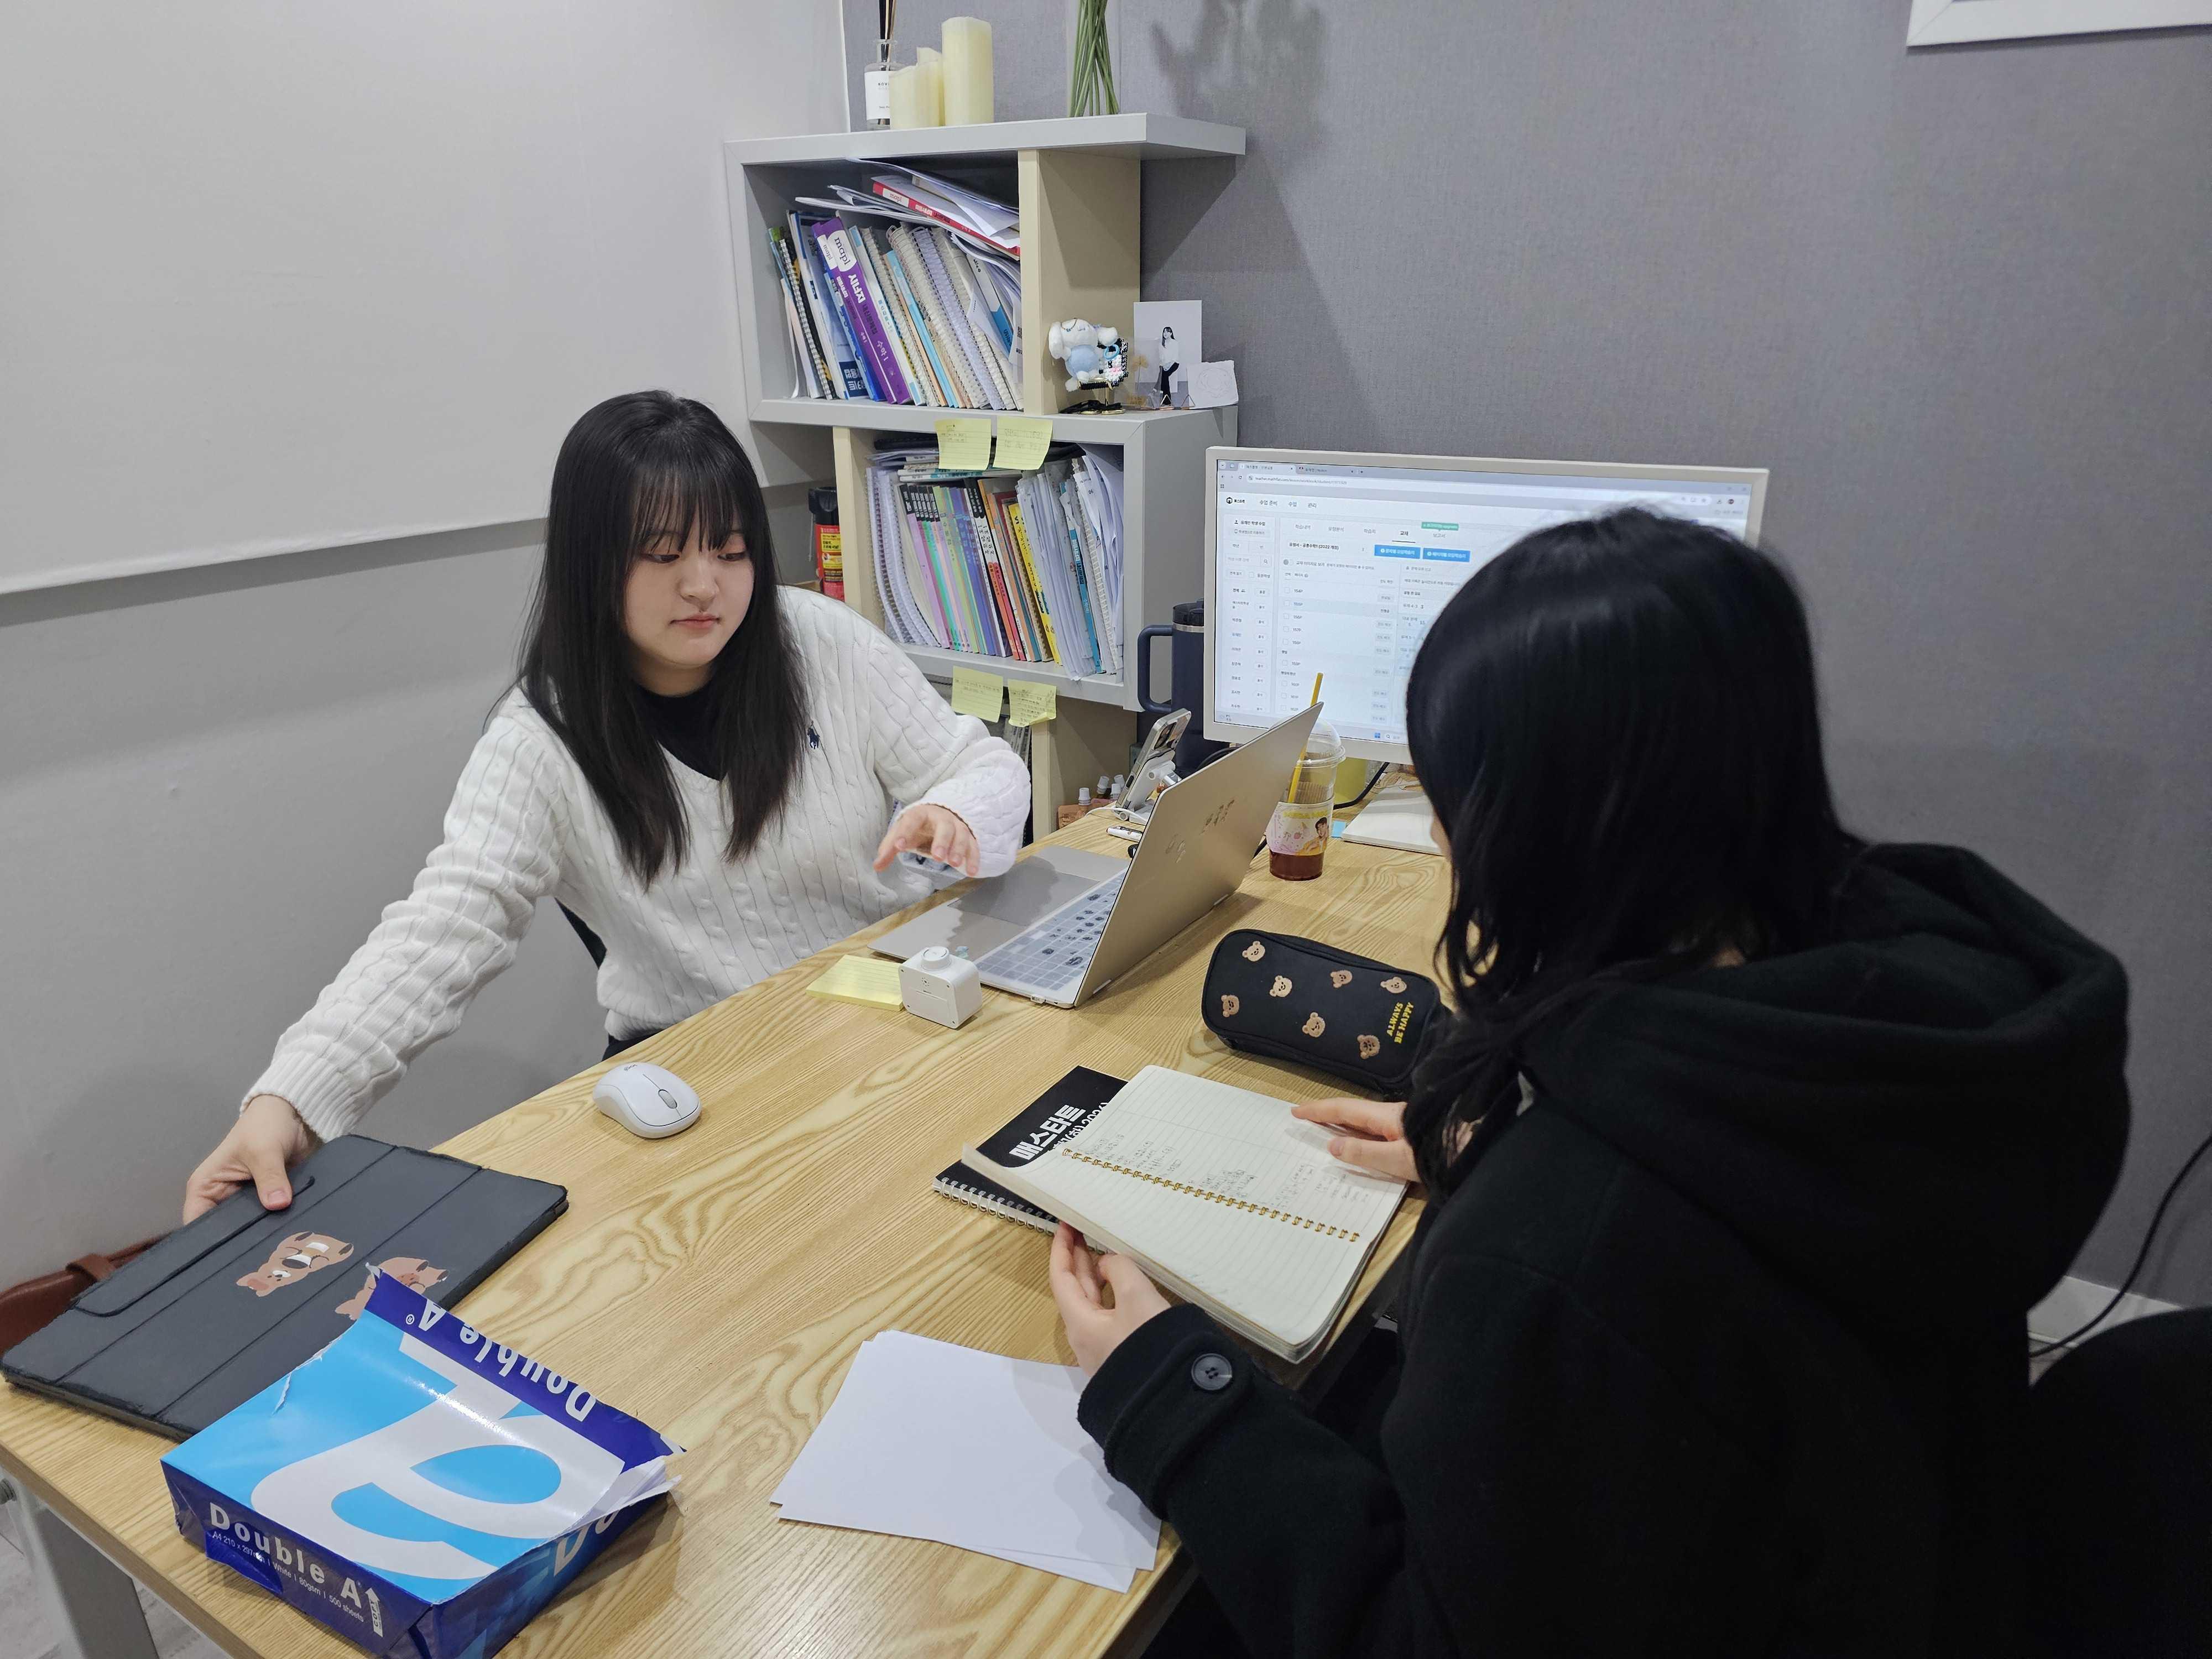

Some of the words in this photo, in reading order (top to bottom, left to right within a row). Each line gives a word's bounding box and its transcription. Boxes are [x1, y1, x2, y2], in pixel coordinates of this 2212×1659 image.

[834, 237, 851, 265] mapl
[848, 274, 866, 304] 시너지
[1386, 1002, 1404, 1036] ALWAYS
[1398, 1001, 1414, 1031] HAPPY
[1394, 1031, 1404, 1044] BE
[1009, 1104, 1087, 1160] 매스타트
[460, 1322, 597, 1422] Double
[210, 1502, 325, 1584] Double
[212, 1531, 222, 1540] A4
[223, 1536, 236, 1546] 210
[273, 1562, 292, 1578] White
[299, 1577, 321, 1595] 80gsm
[328, 1595, 341, 1609] 500
[342, 1605, 364, 1623] sheets
